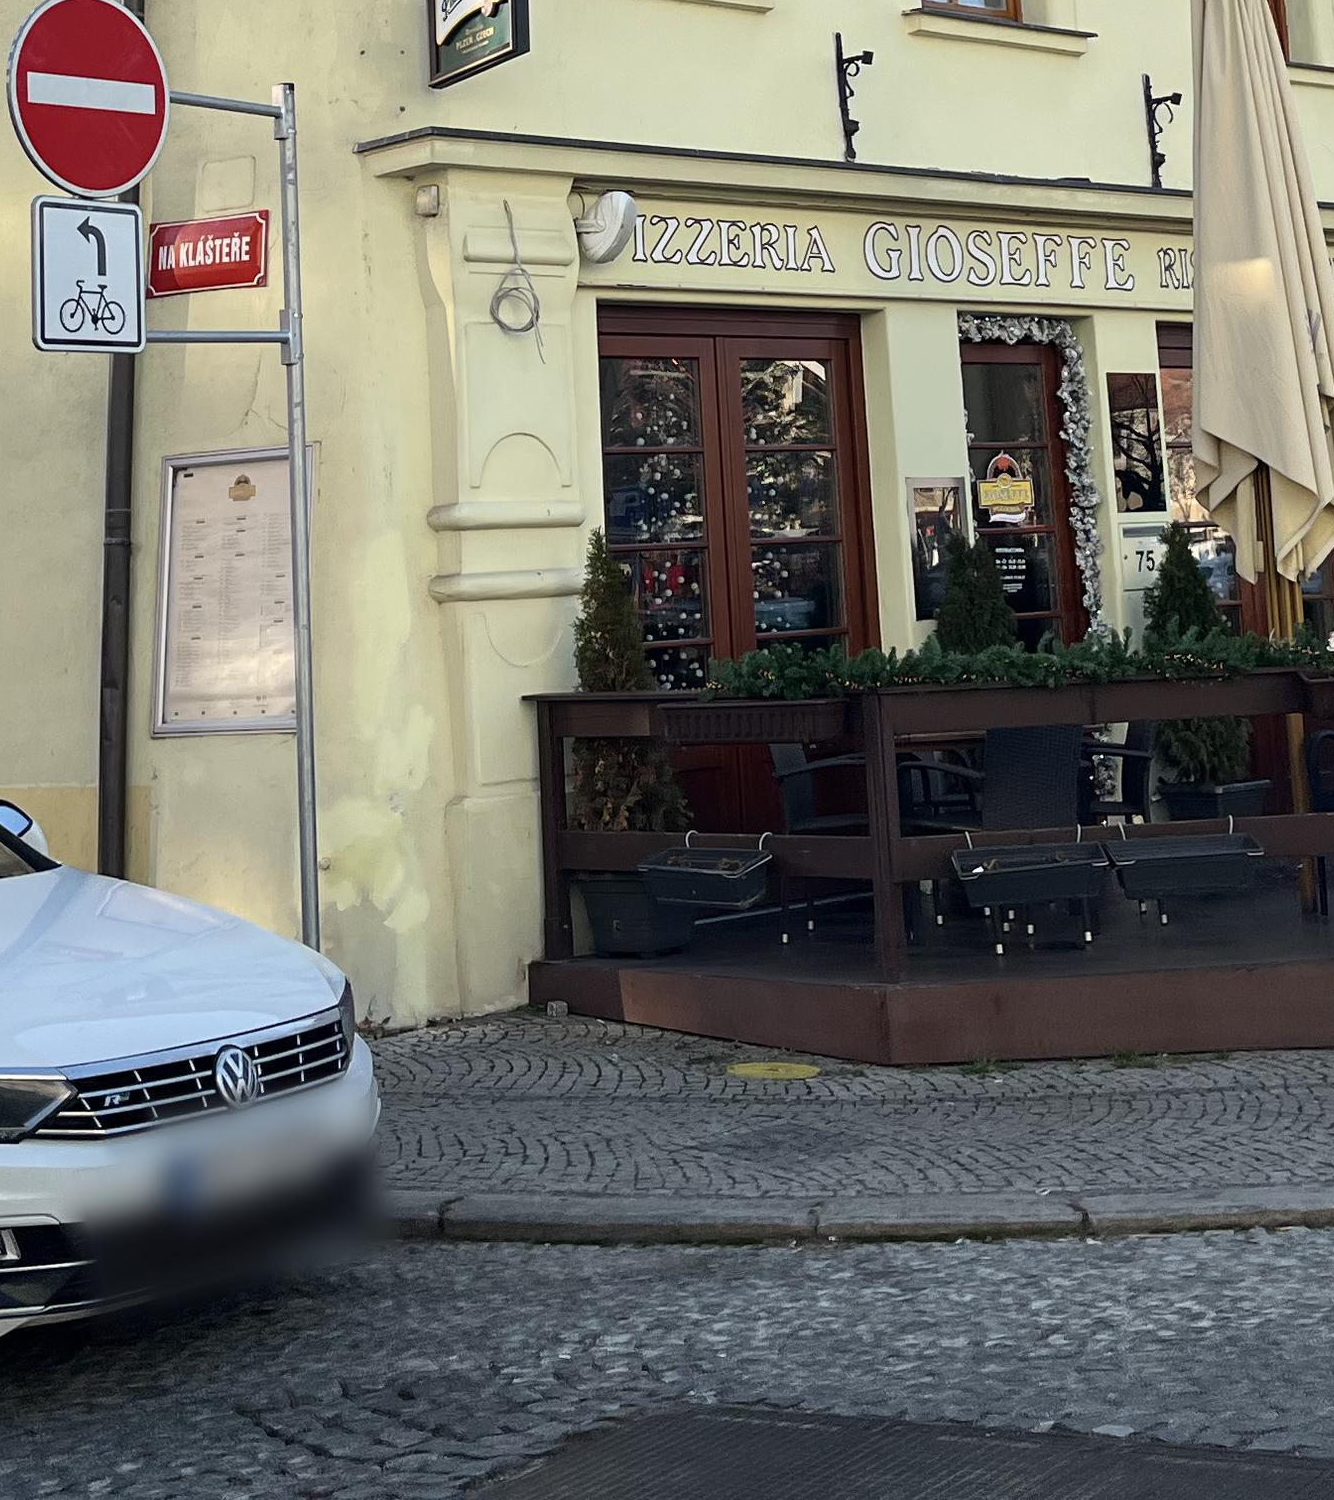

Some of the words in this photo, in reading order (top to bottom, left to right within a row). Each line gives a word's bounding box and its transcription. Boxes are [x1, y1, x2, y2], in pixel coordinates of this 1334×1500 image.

[158, 243, 176, 270] NA
[179, 231, 251, 268] KLÁŠTEŘE
[632, 214, 836, 273] IZZERIA
[863, 221, 1135, 291] GIOSEFFE
[1135, 550, 1155, 572] 75
